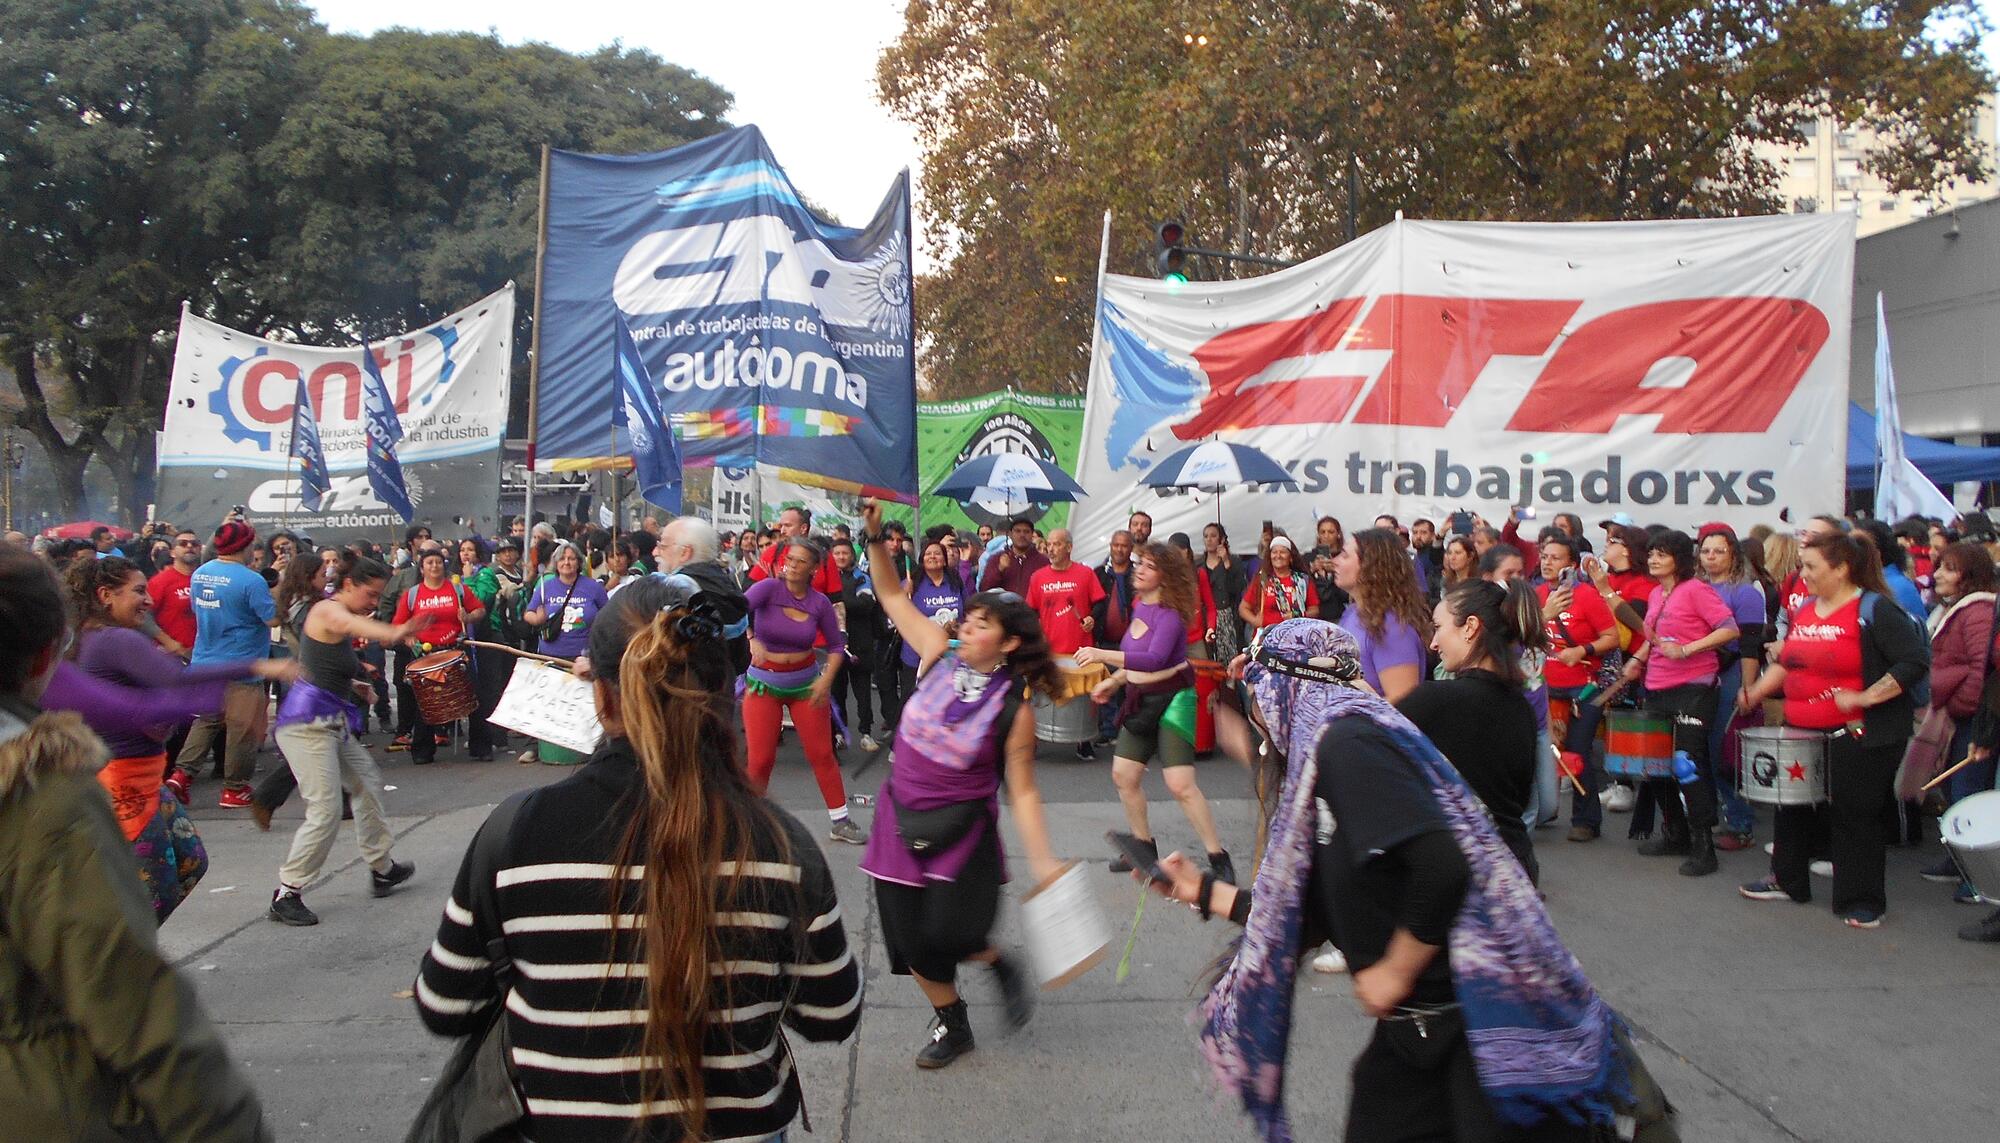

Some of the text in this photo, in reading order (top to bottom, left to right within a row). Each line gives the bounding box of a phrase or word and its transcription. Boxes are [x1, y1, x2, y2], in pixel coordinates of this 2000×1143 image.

[674, 320, 696, 336] de
[794, 315, 818, 336] de
[1170, 294, 1830, 440] CTA
[917, 401, 970, 414] CIACIÓN
[441, 412, 462, 425] de
[983, 417, 1003, 432] 100
[409, 431, 422, 442] la
[427, 423, 489, 441] industria
[1248, 459, 1330, 495] xs
[1344, 449, 1777, 507] trabajadorxs
[325, 512, 404, 529] autónoma
[1294, 666, 1342, 683] SIMPS
